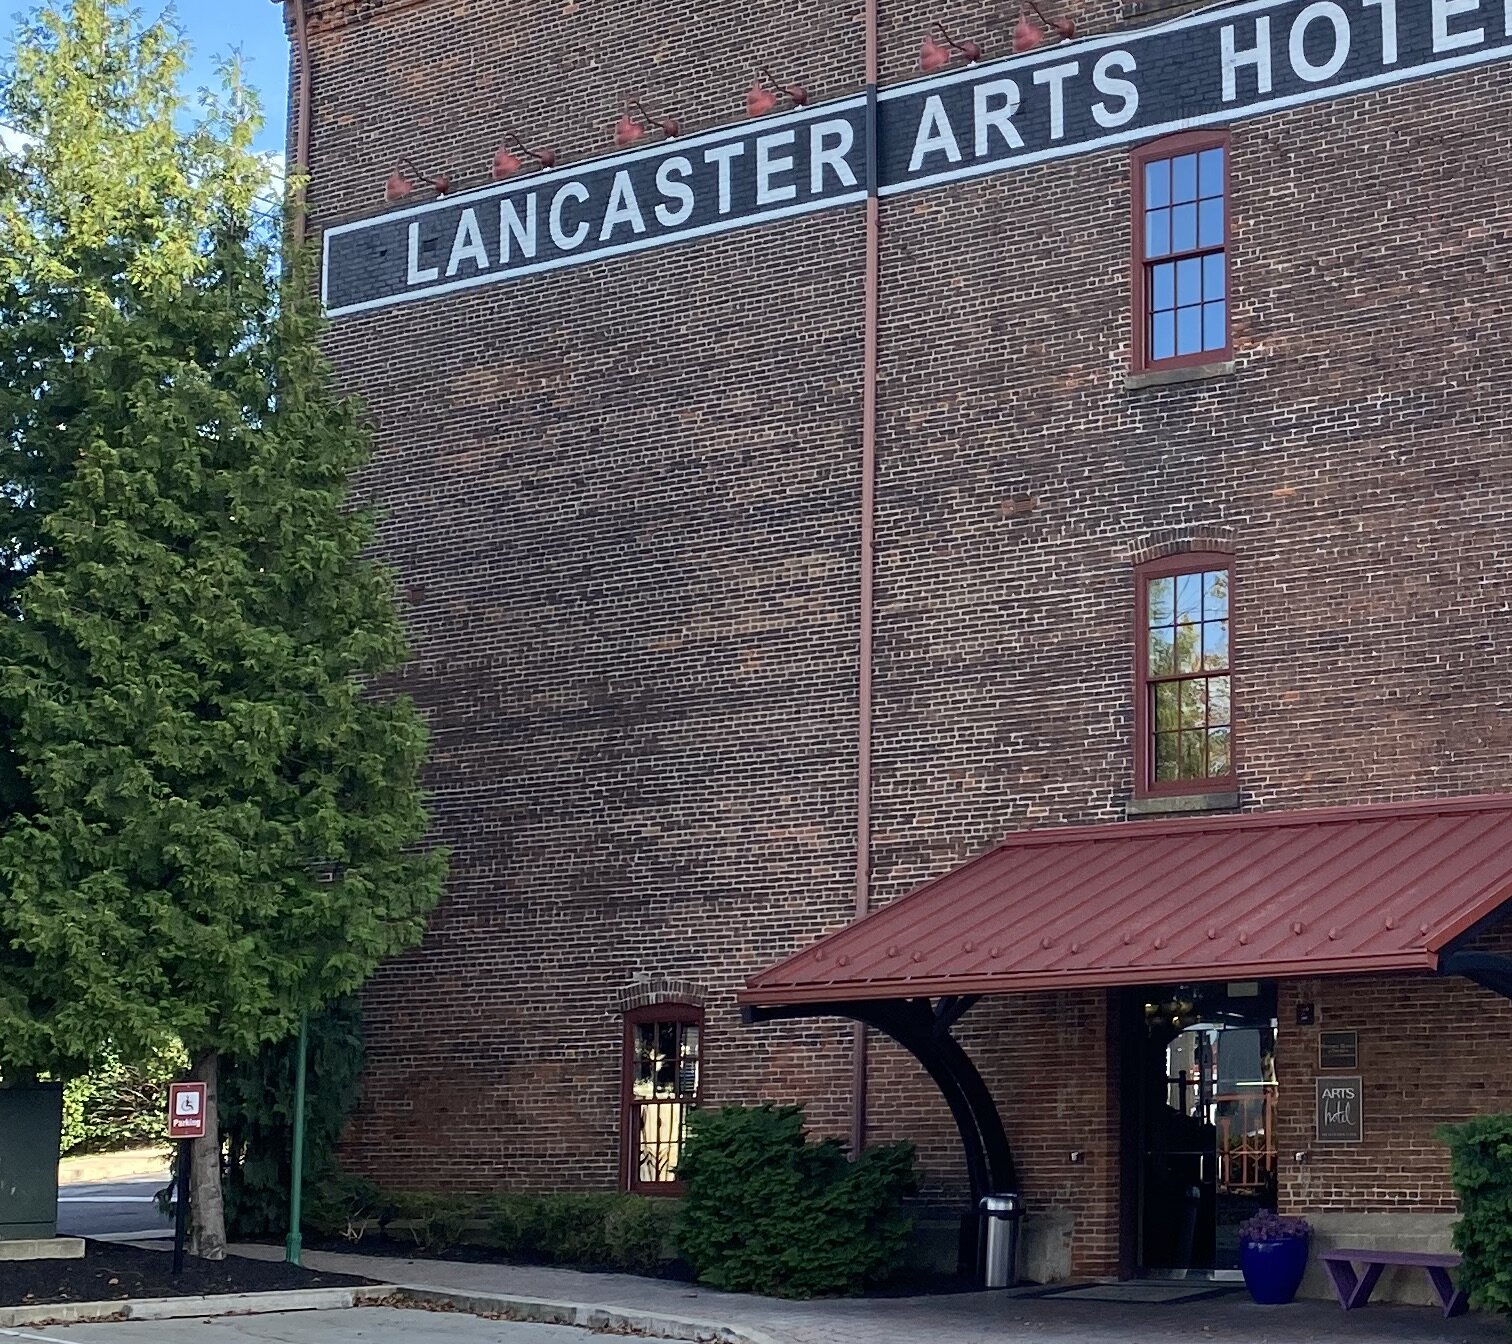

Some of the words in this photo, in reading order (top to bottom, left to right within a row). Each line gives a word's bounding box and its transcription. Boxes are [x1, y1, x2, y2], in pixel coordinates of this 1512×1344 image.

[406, 118, 859, 286] LANCASTER
[907, 49, 1140, 172] ARTS
[1321, 1087, 1356, 1099] ARTS
[1323, 1097, 1356, 1126] hotel
[172, 1118, 201, 1128] Parking
